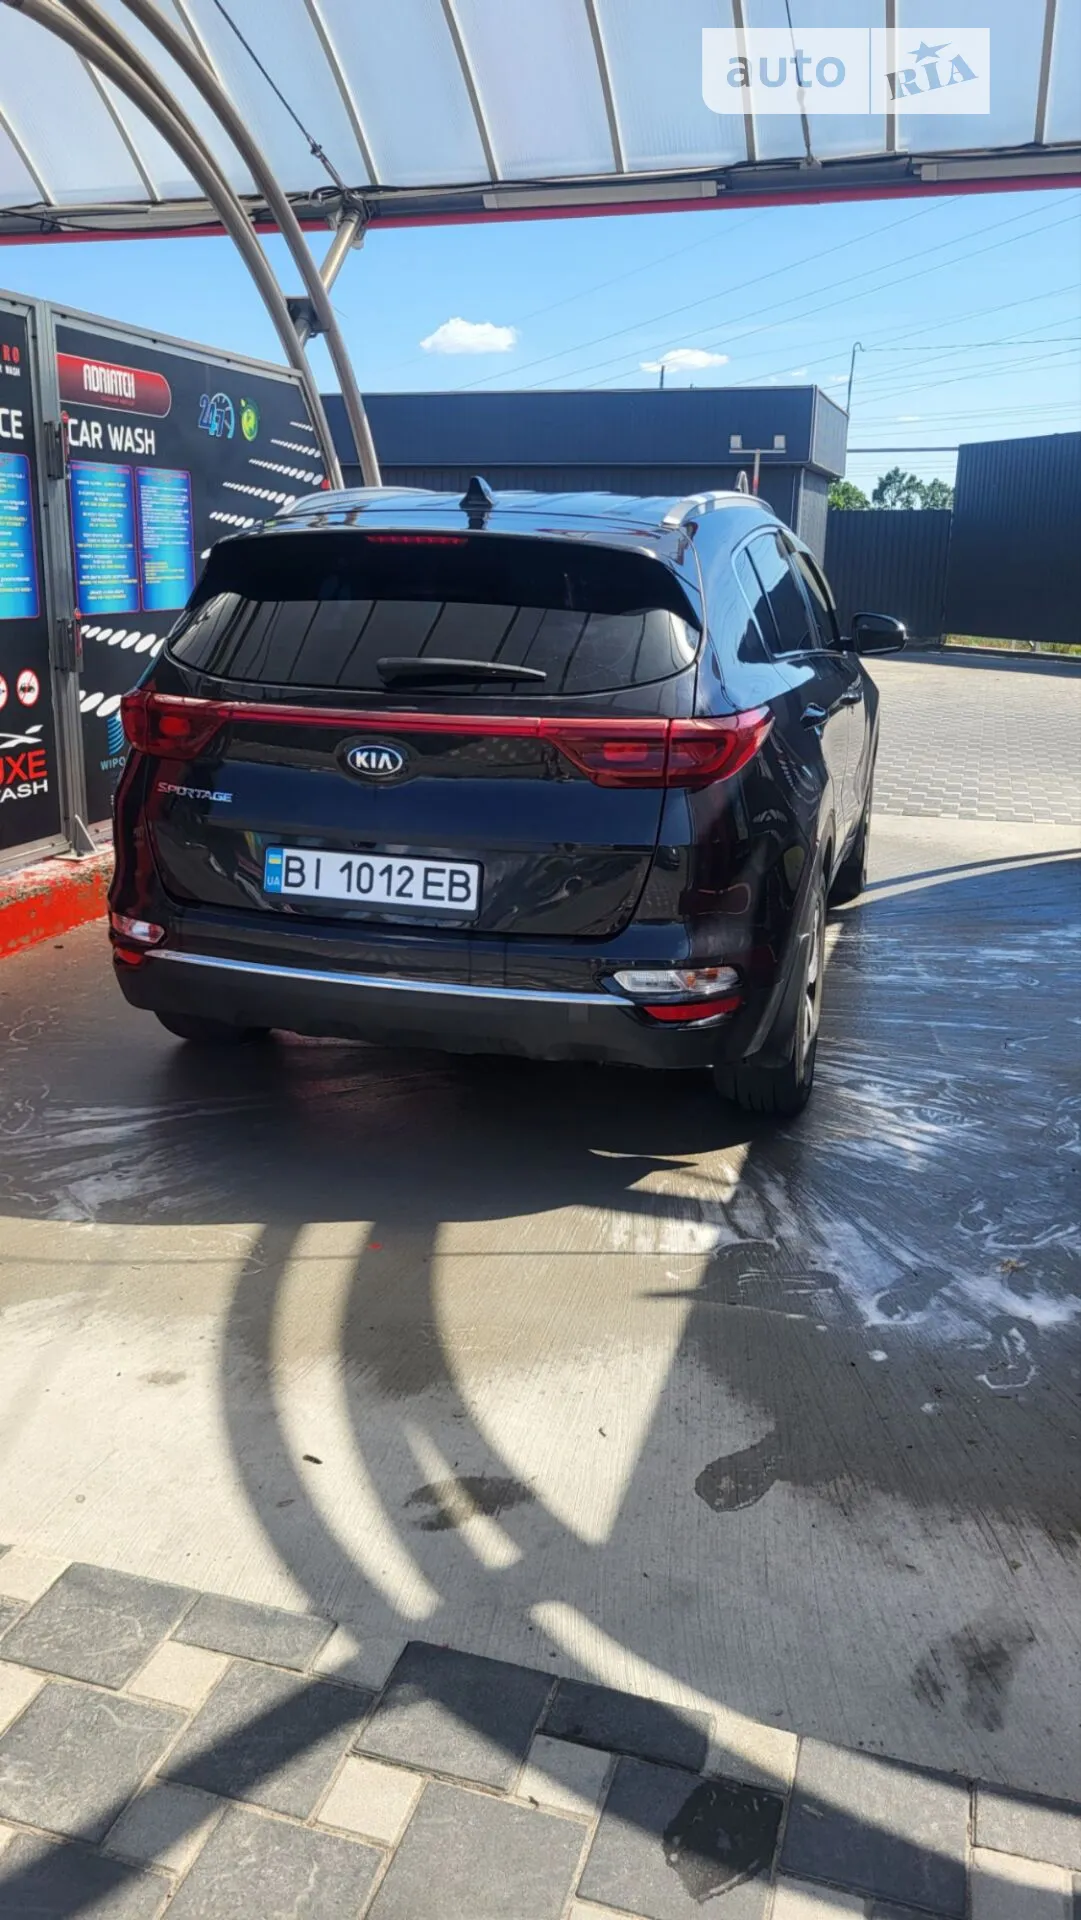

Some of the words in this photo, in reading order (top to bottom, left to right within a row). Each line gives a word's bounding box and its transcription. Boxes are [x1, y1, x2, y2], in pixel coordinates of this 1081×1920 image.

[67, 418, 103, 450] CAR
[107, 423, 156, 456] WASH
[355, 750, 393, 771] KIA
[0, 779, 48, 804] ASH
[157, 782, 233, 803] SPORTAGE
[267, 876, 280, 886] UA
